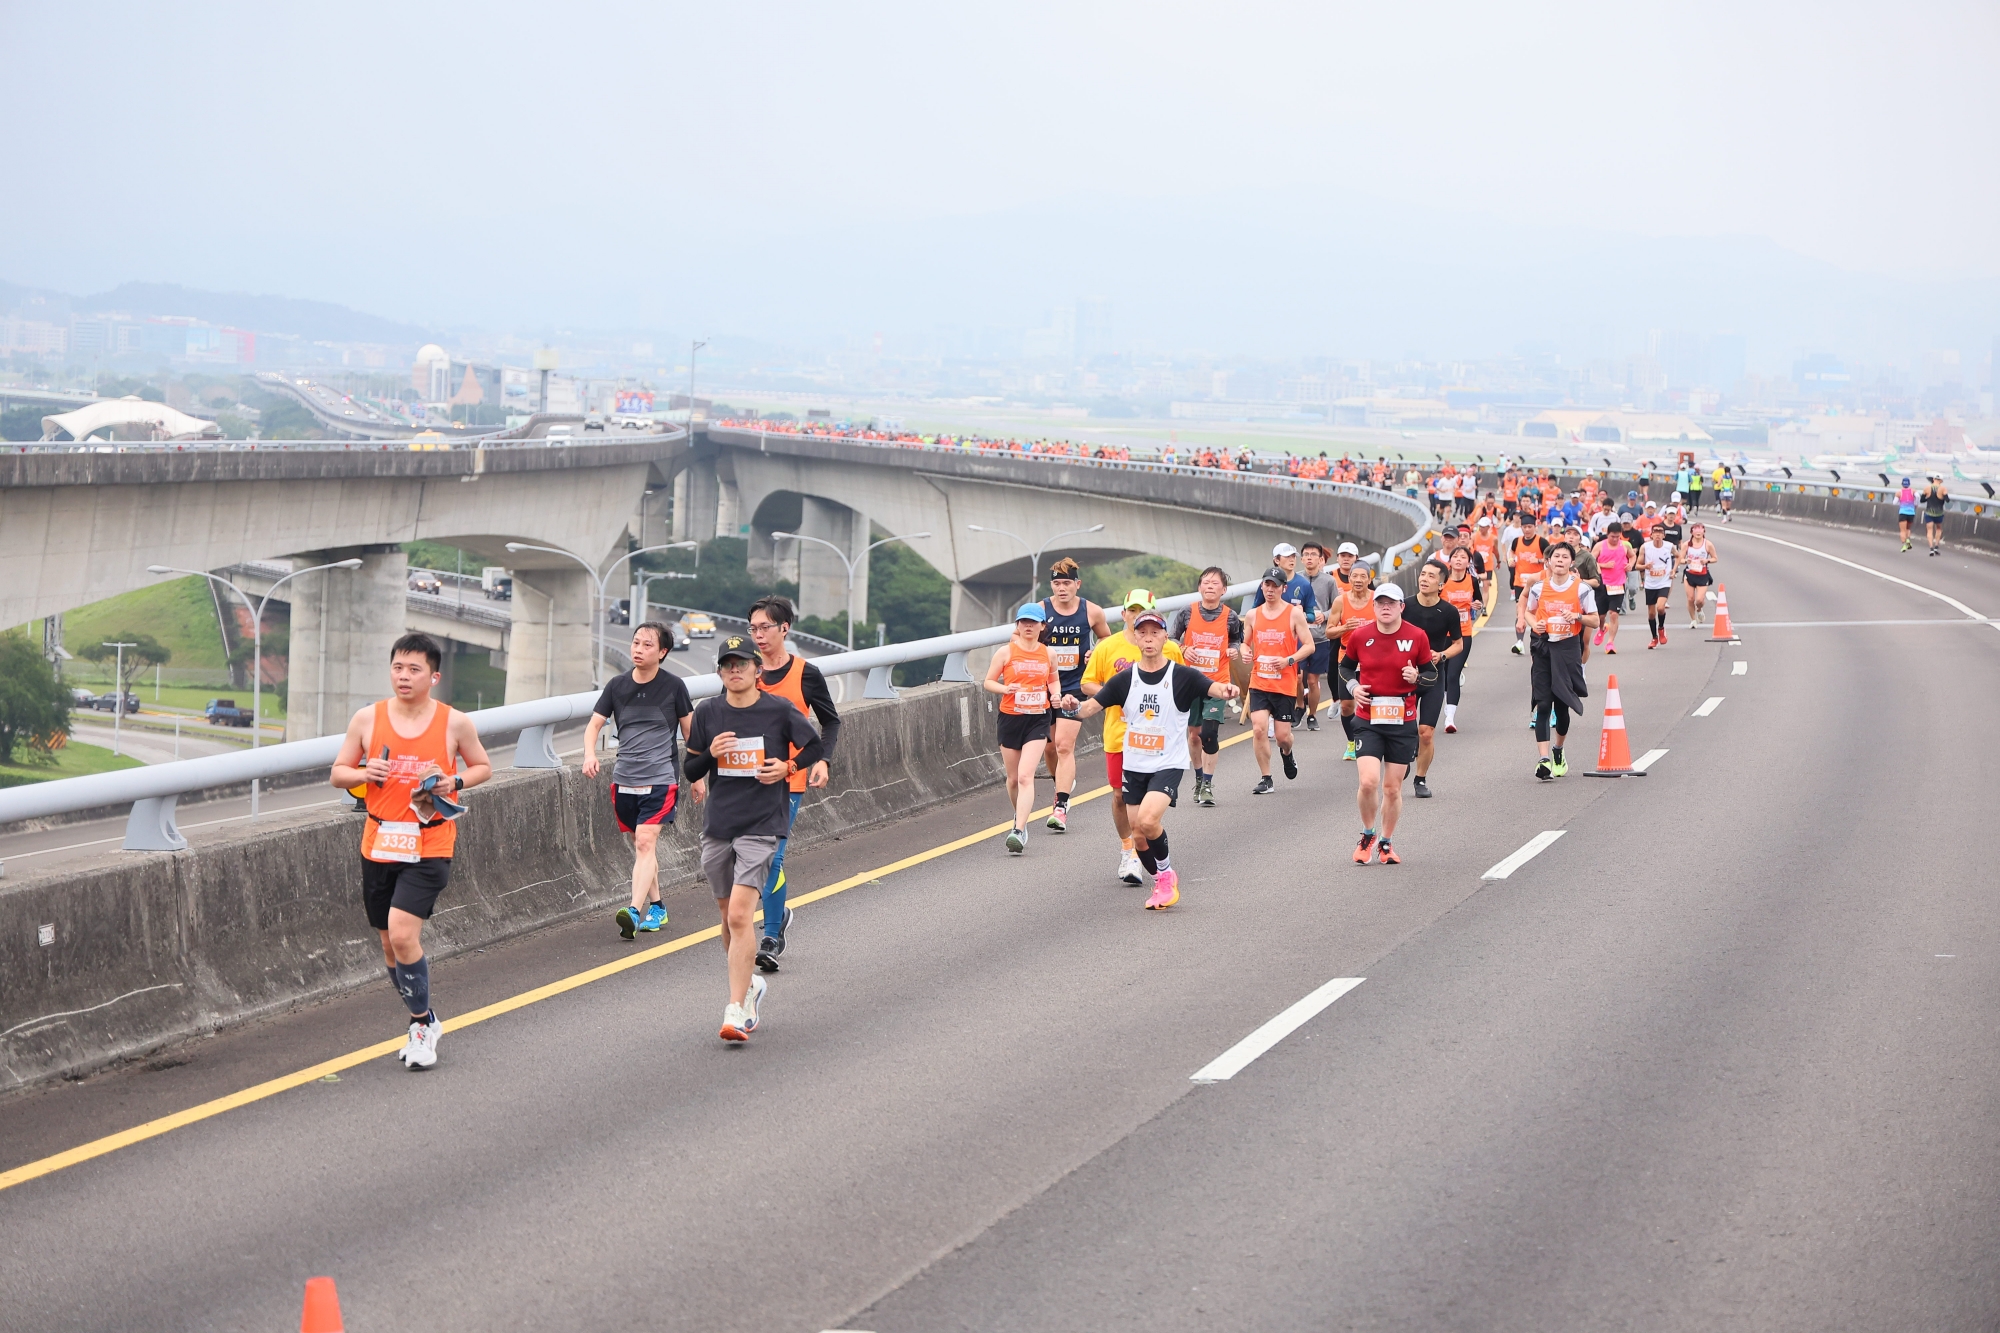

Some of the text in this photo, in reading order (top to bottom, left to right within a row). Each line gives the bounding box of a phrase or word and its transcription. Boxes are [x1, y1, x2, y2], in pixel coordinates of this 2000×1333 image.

[1052, 626, 1080, 634] ASICS
[1551, 624, 1571, 632] 1272
[1051, 637, 1080, 645] RUN
[1396, 639, 1413, 652] W
[1057, 655, 1075, 664] 078
[1020, 693, 1041, 702] 5750
[1142, 693, 1158, 704] AKE
[1375, 706, 1399, 716] 1130
[1133, 734, 1159, 747] 1127
[723, 751, 758, 765] 1394
[381, 834, 417, 850] 3328
